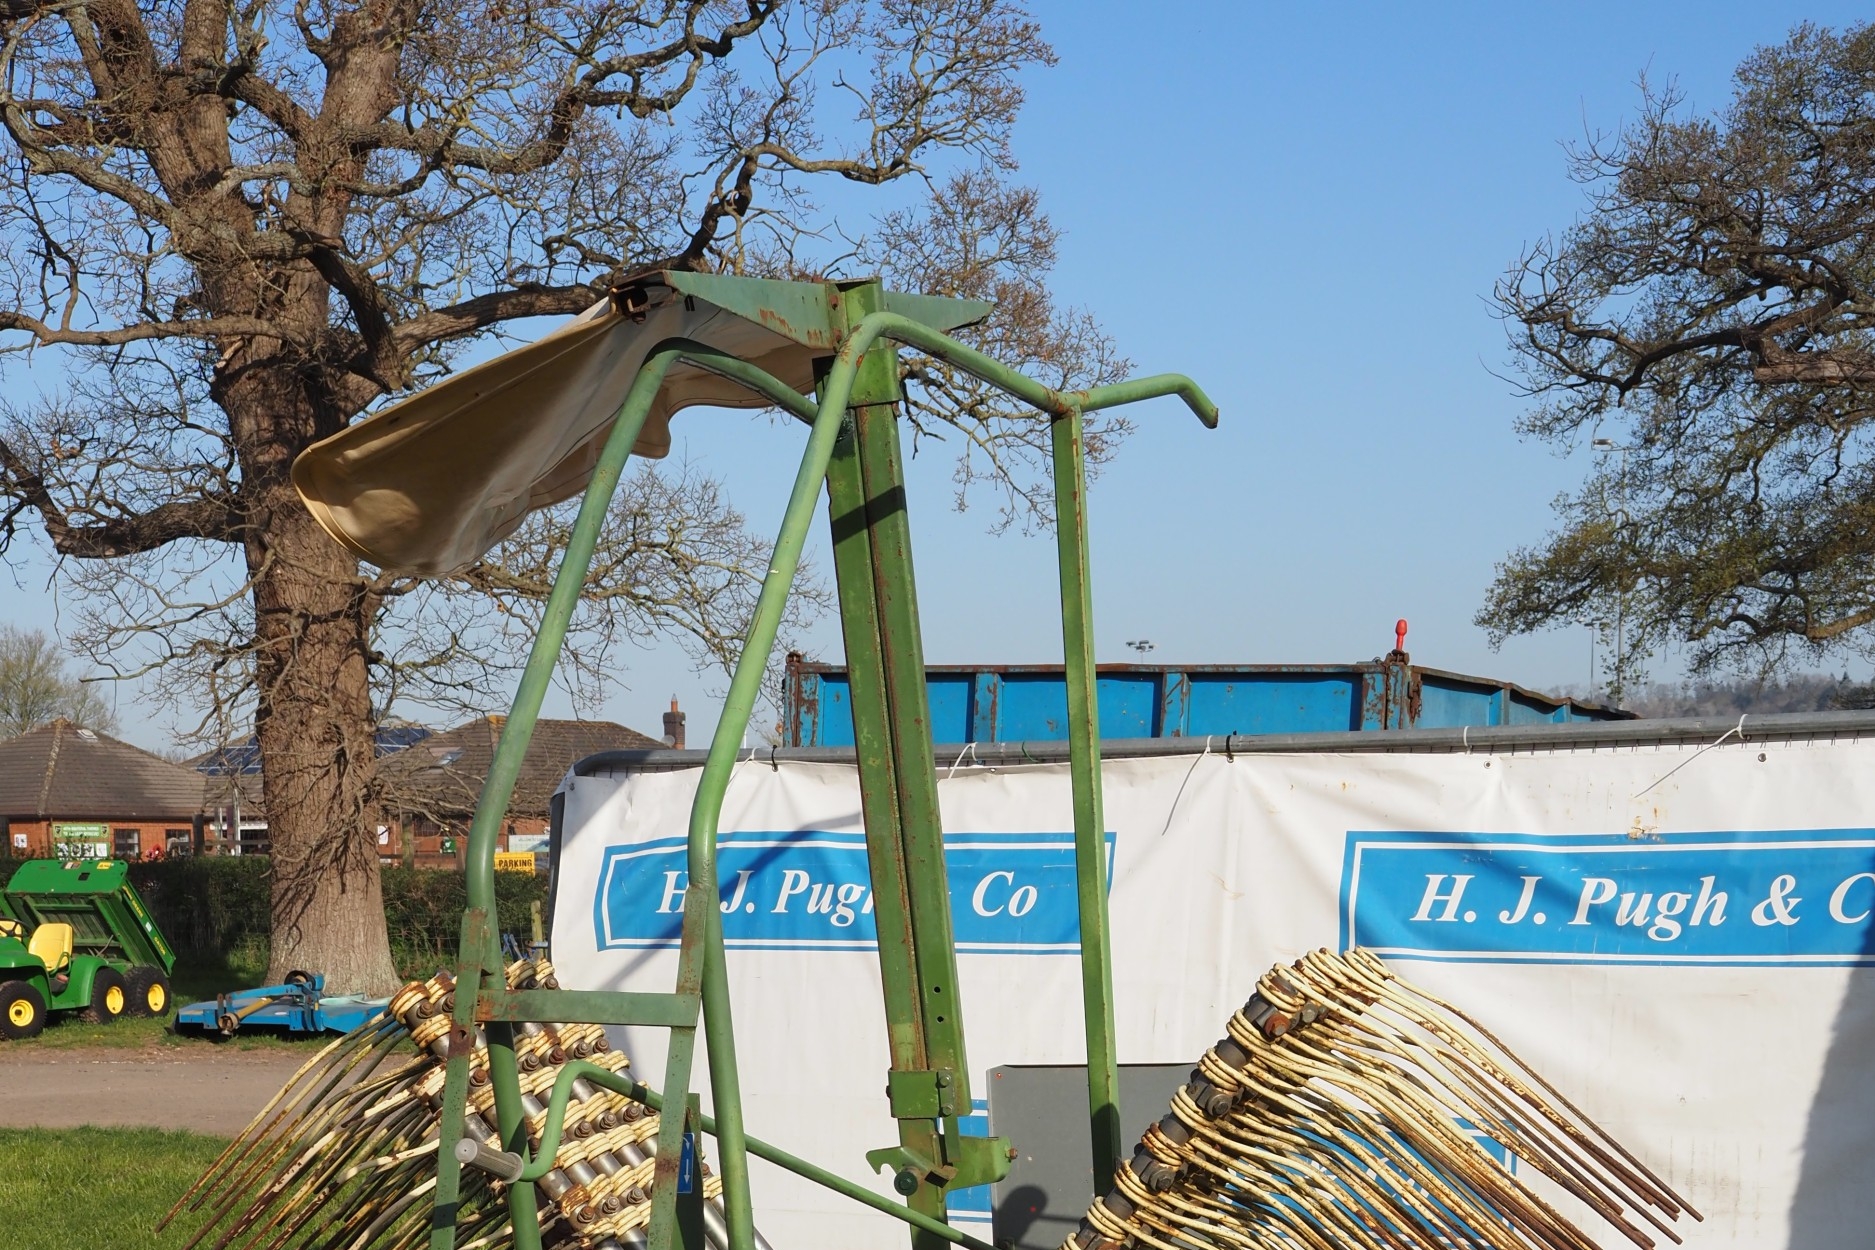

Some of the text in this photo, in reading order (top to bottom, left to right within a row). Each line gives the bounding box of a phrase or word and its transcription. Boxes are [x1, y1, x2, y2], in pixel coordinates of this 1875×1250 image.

[498, 859, 532, 869] PARKING
[656, 870, 876, 927] H J. Pug
[972, 870, 1038, 917] Co
[1409, 874, 1477, 924] H.
[1499, 876, 1546, 925] J.
[1567, 875, 1729, 942] Pugh
[1750, 873, 1803, 927] &
